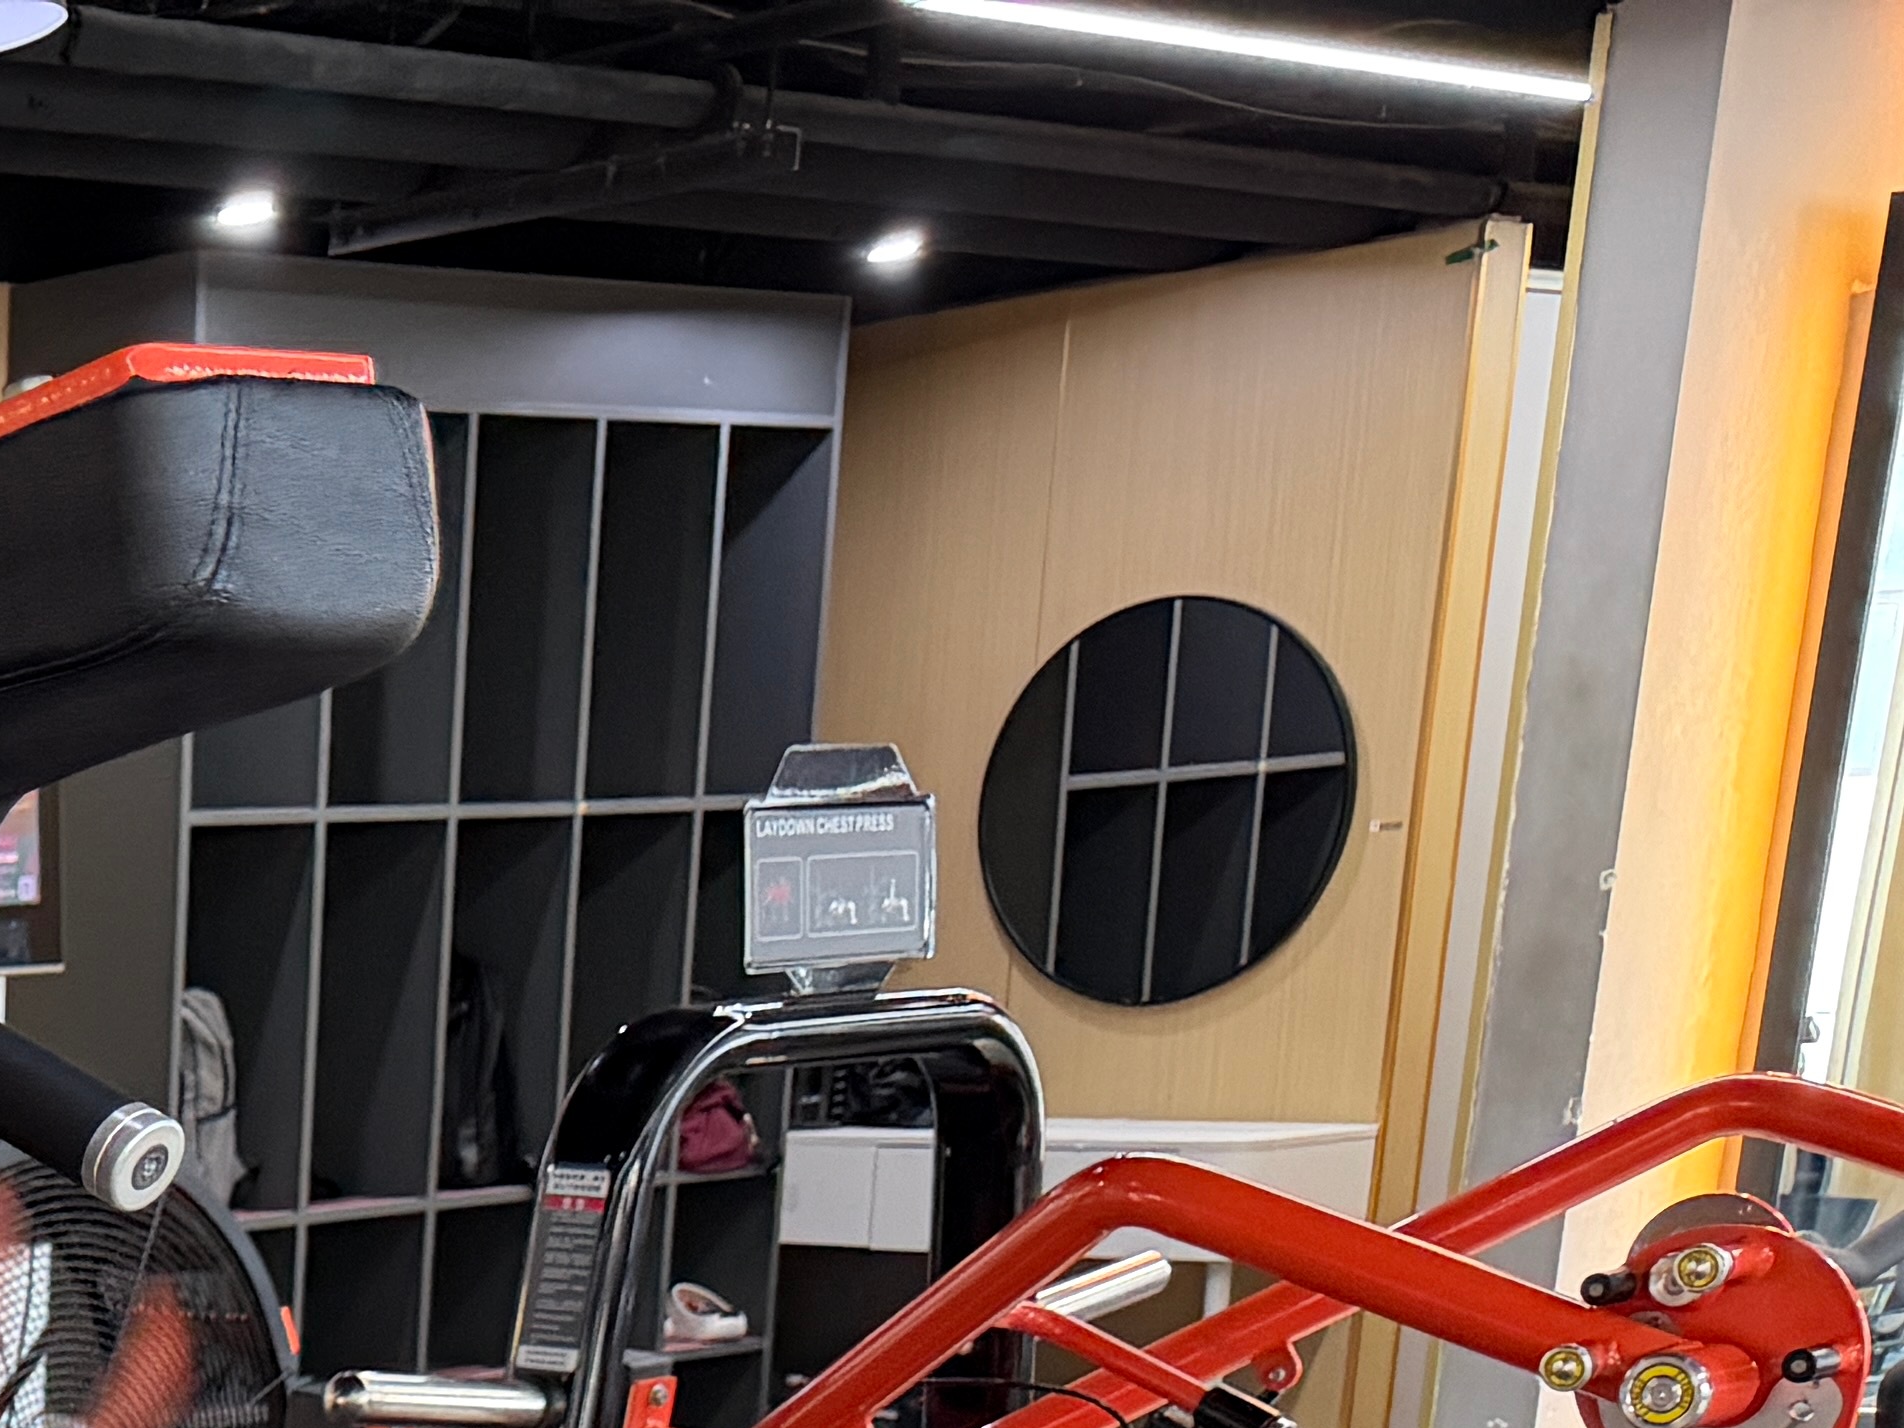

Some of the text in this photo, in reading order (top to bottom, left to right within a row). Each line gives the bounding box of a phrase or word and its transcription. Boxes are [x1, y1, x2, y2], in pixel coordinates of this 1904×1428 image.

[755, 813, 894, 838] LAYDOWN CHEST PRESS
